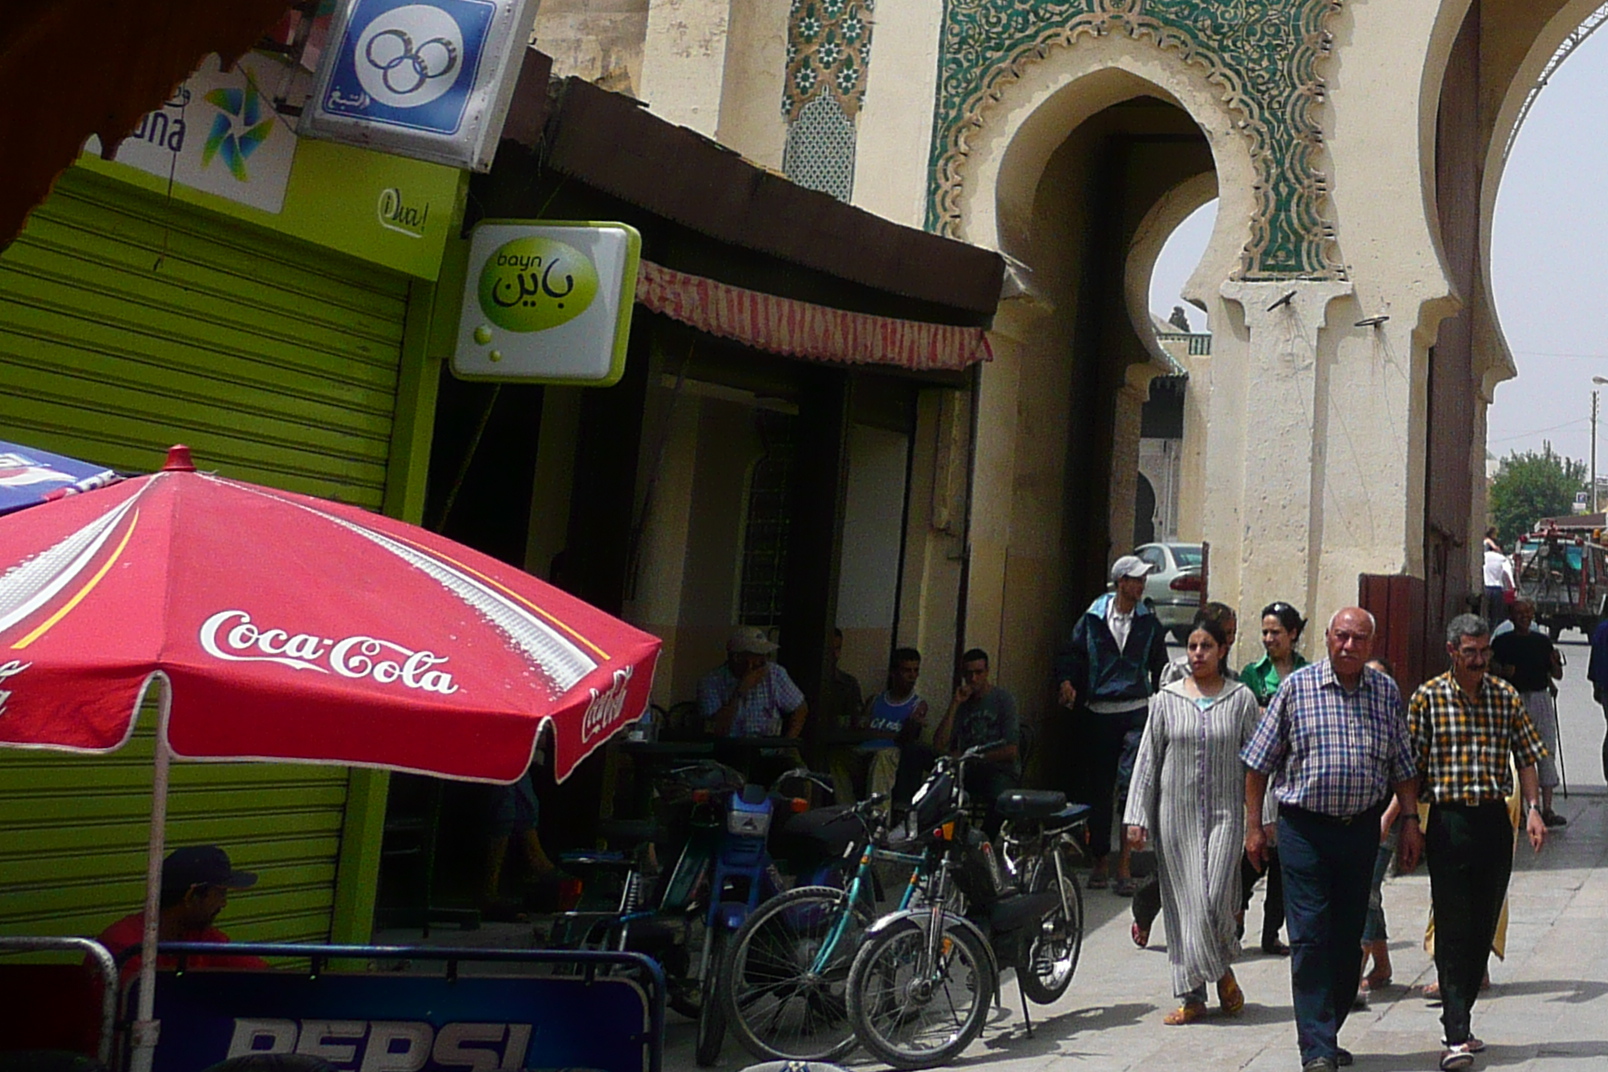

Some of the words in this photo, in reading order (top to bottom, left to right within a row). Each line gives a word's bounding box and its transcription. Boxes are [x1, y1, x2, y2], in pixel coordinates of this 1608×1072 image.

[492, 258, 574, 309] باين
[497, 253, 542, 271] bayn
[200, 610, 458, 695] Coca-Cola
[226, 1017, 533, 1072] PEPSI
